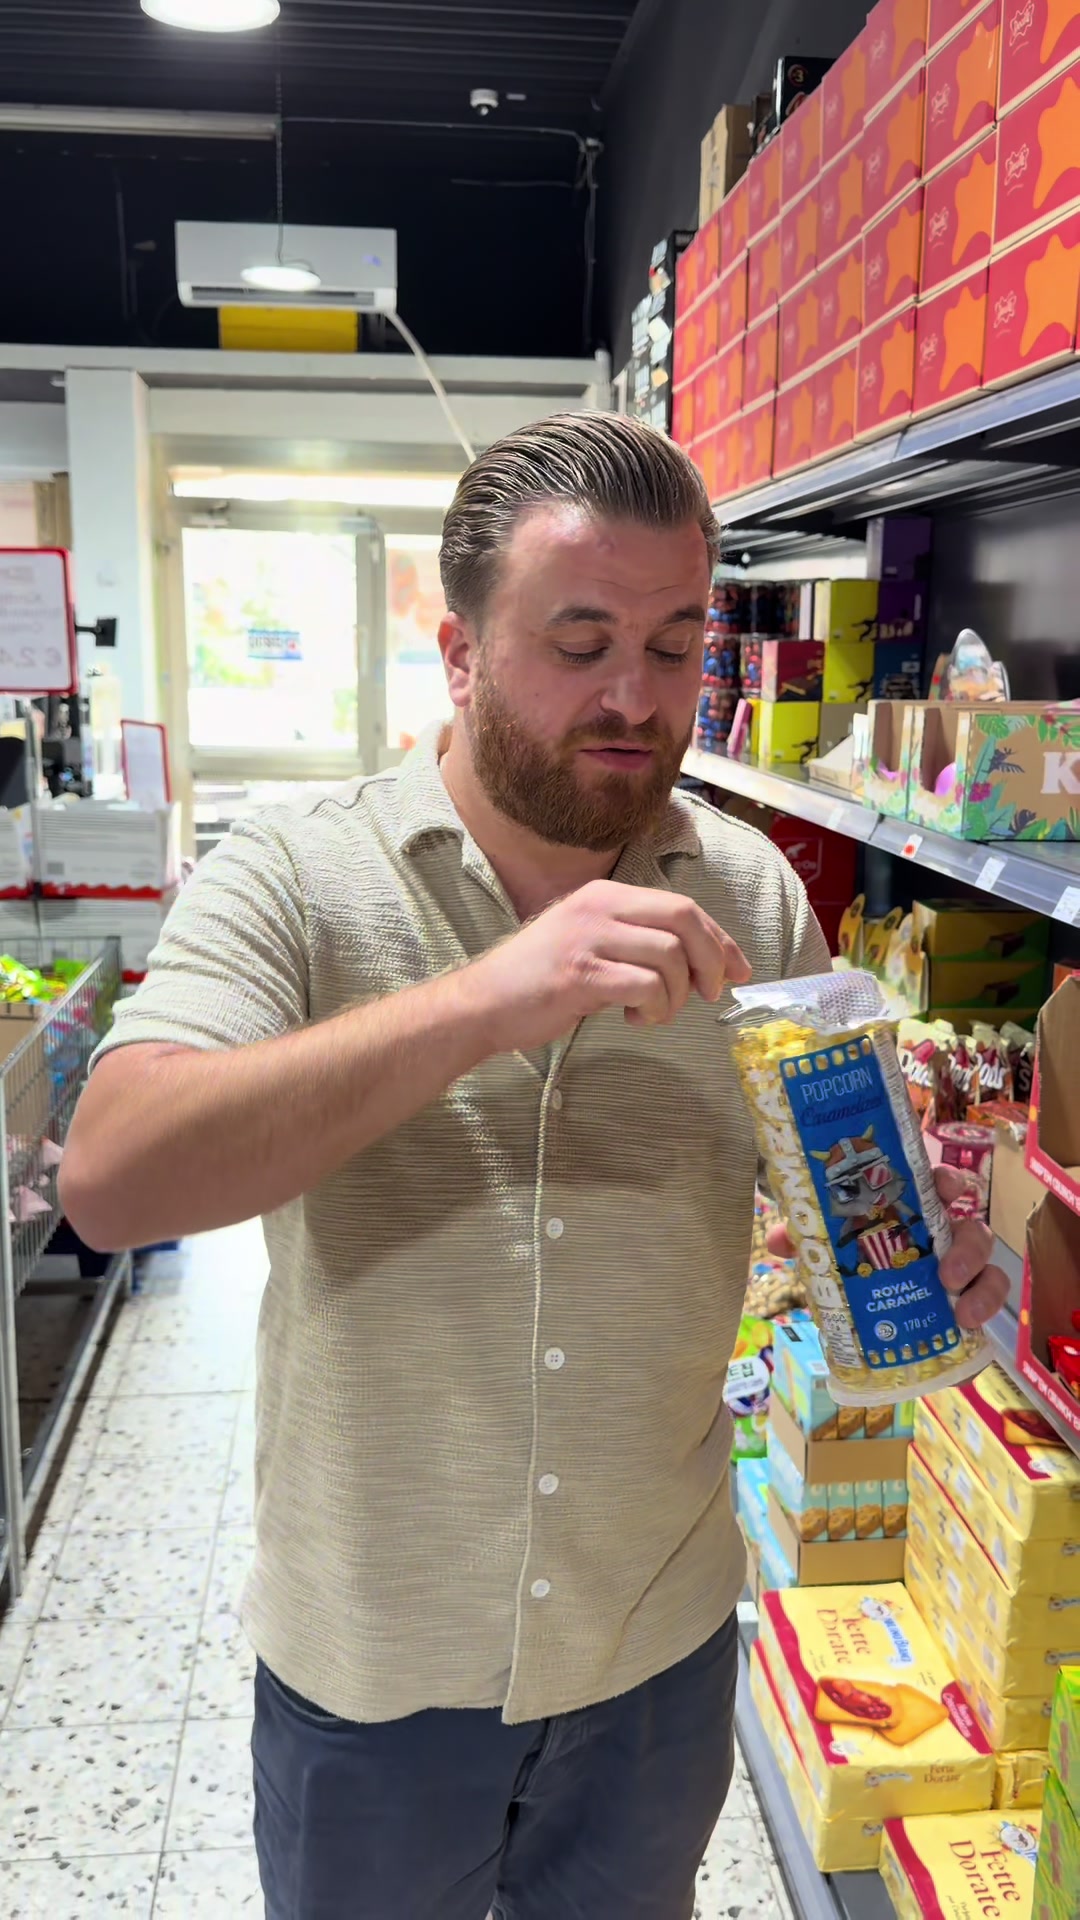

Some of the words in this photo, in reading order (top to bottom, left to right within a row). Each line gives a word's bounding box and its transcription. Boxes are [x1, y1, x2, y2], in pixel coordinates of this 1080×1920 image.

[801, 1065, 873, 1104] POPCORN
[866, 1287, 933, 1313] CARAMEL
[871, 1279, 918, 1300] ROYAL
[904, 1318, 920, 1332] 170
[948, 1840, 1001, 1918] Dorate
[980, 1850, 1021, 1902] Fette
